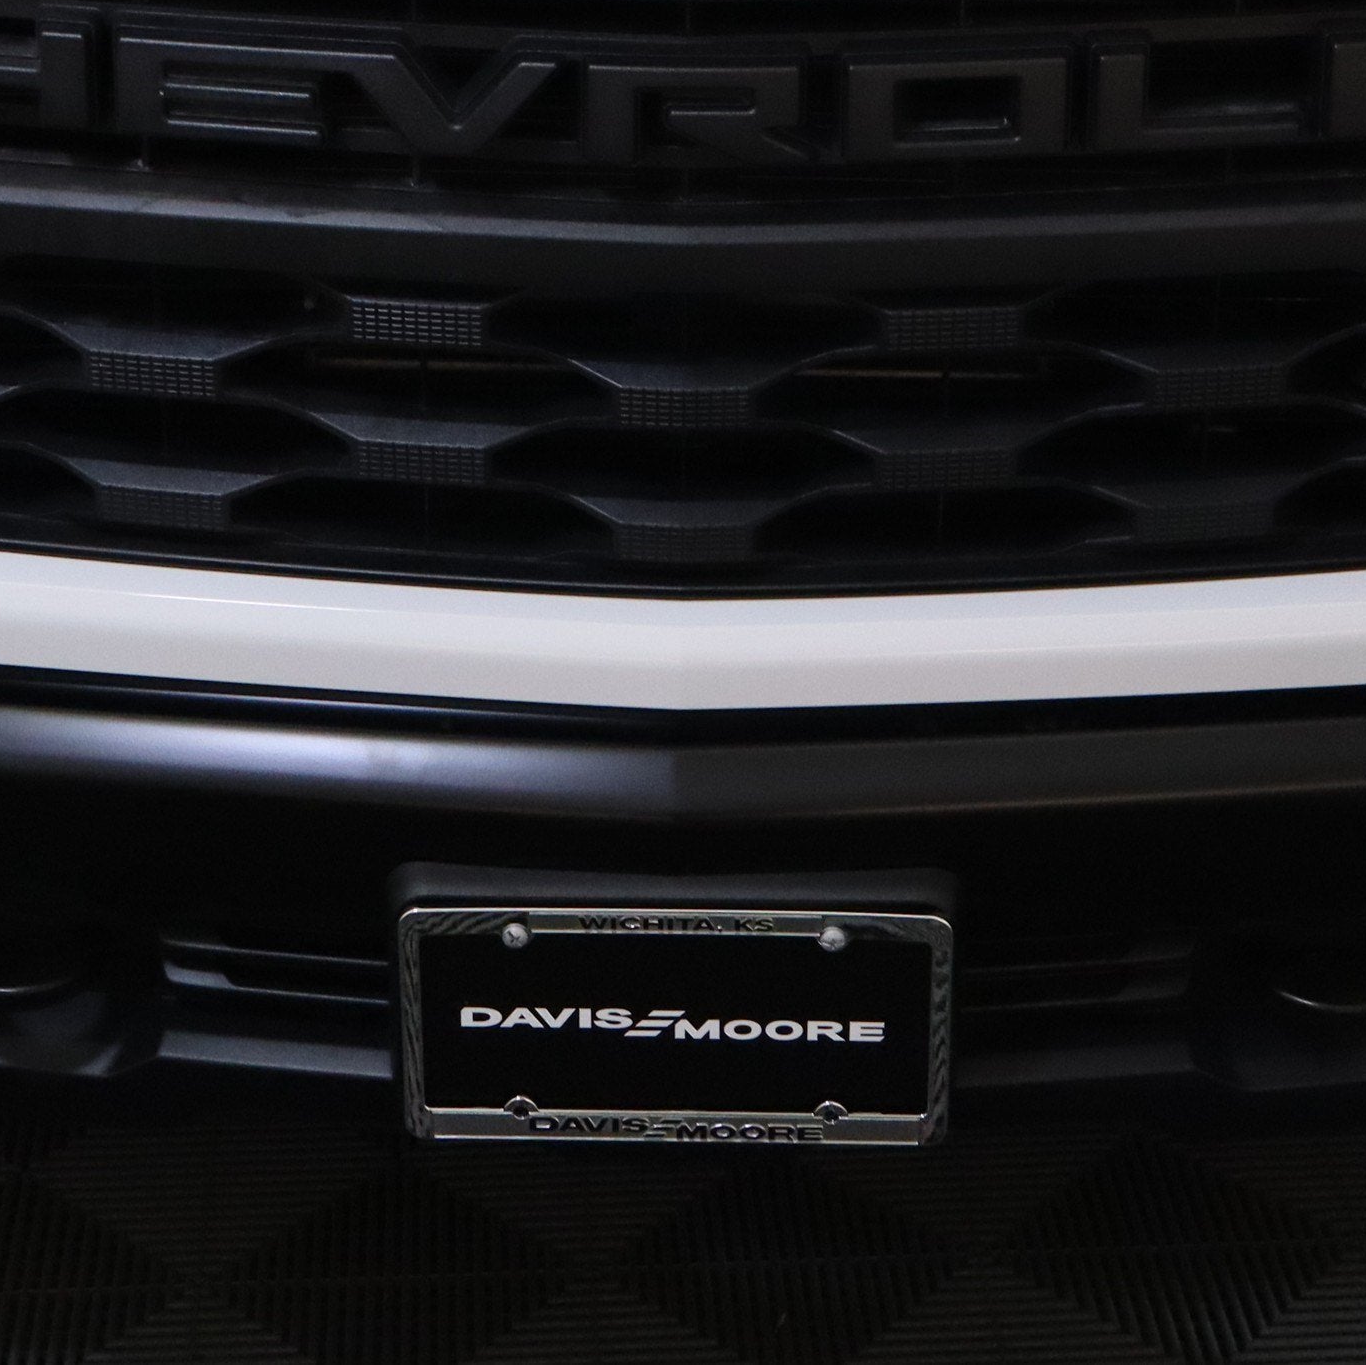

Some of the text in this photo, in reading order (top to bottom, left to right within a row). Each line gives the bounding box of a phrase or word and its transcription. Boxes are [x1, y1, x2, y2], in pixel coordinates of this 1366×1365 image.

[735, 917, 775, 932] KS
[460, 1006, 885, 1042] DAVIS MOORE
[529, 1115, 824, 1142] DAVIS MOORE
